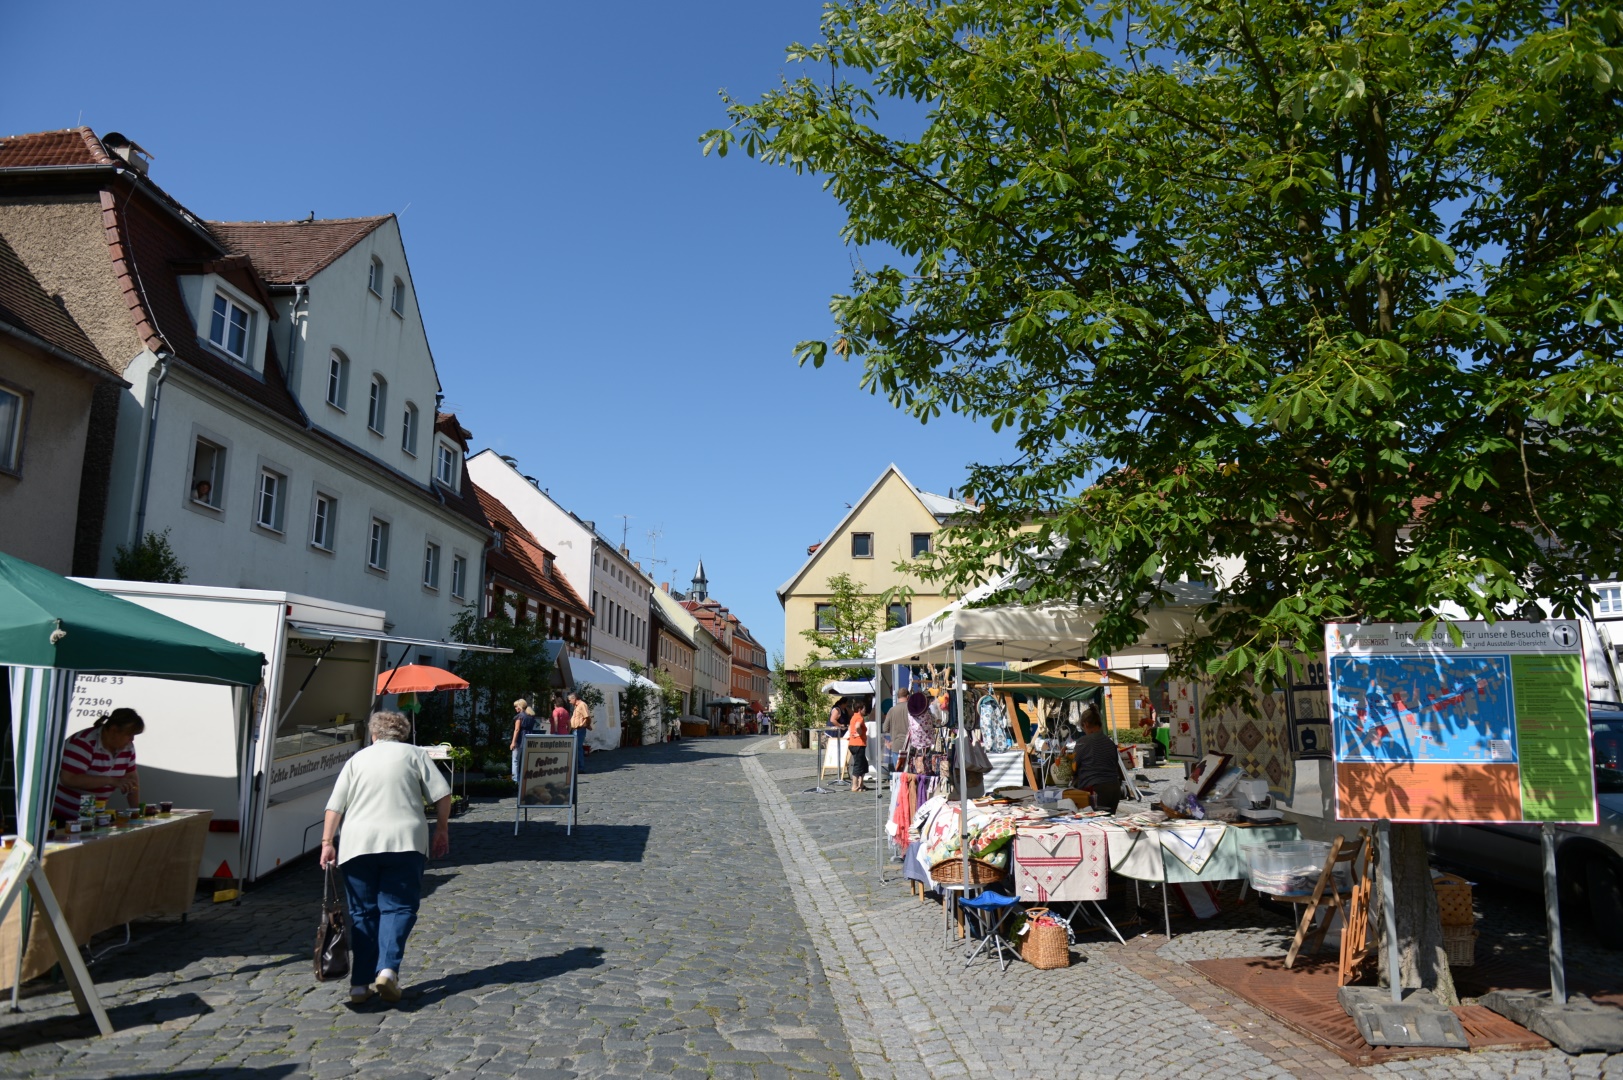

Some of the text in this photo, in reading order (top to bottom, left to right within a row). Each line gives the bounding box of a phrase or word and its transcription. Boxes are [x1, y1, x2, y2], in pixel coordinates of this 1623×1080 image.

[1463, 630, 1475, 640] für
[1510, 630, 1550, 639] Besucher
[110, 676, 124, 685] 33
[79, 697, 112, 707] 72369
[527, 740, 571, 749] Wir empfehlen
[289, 760, 320, 779] Pulsnitzer
[525, 756, 569, 779] feine Makronen
